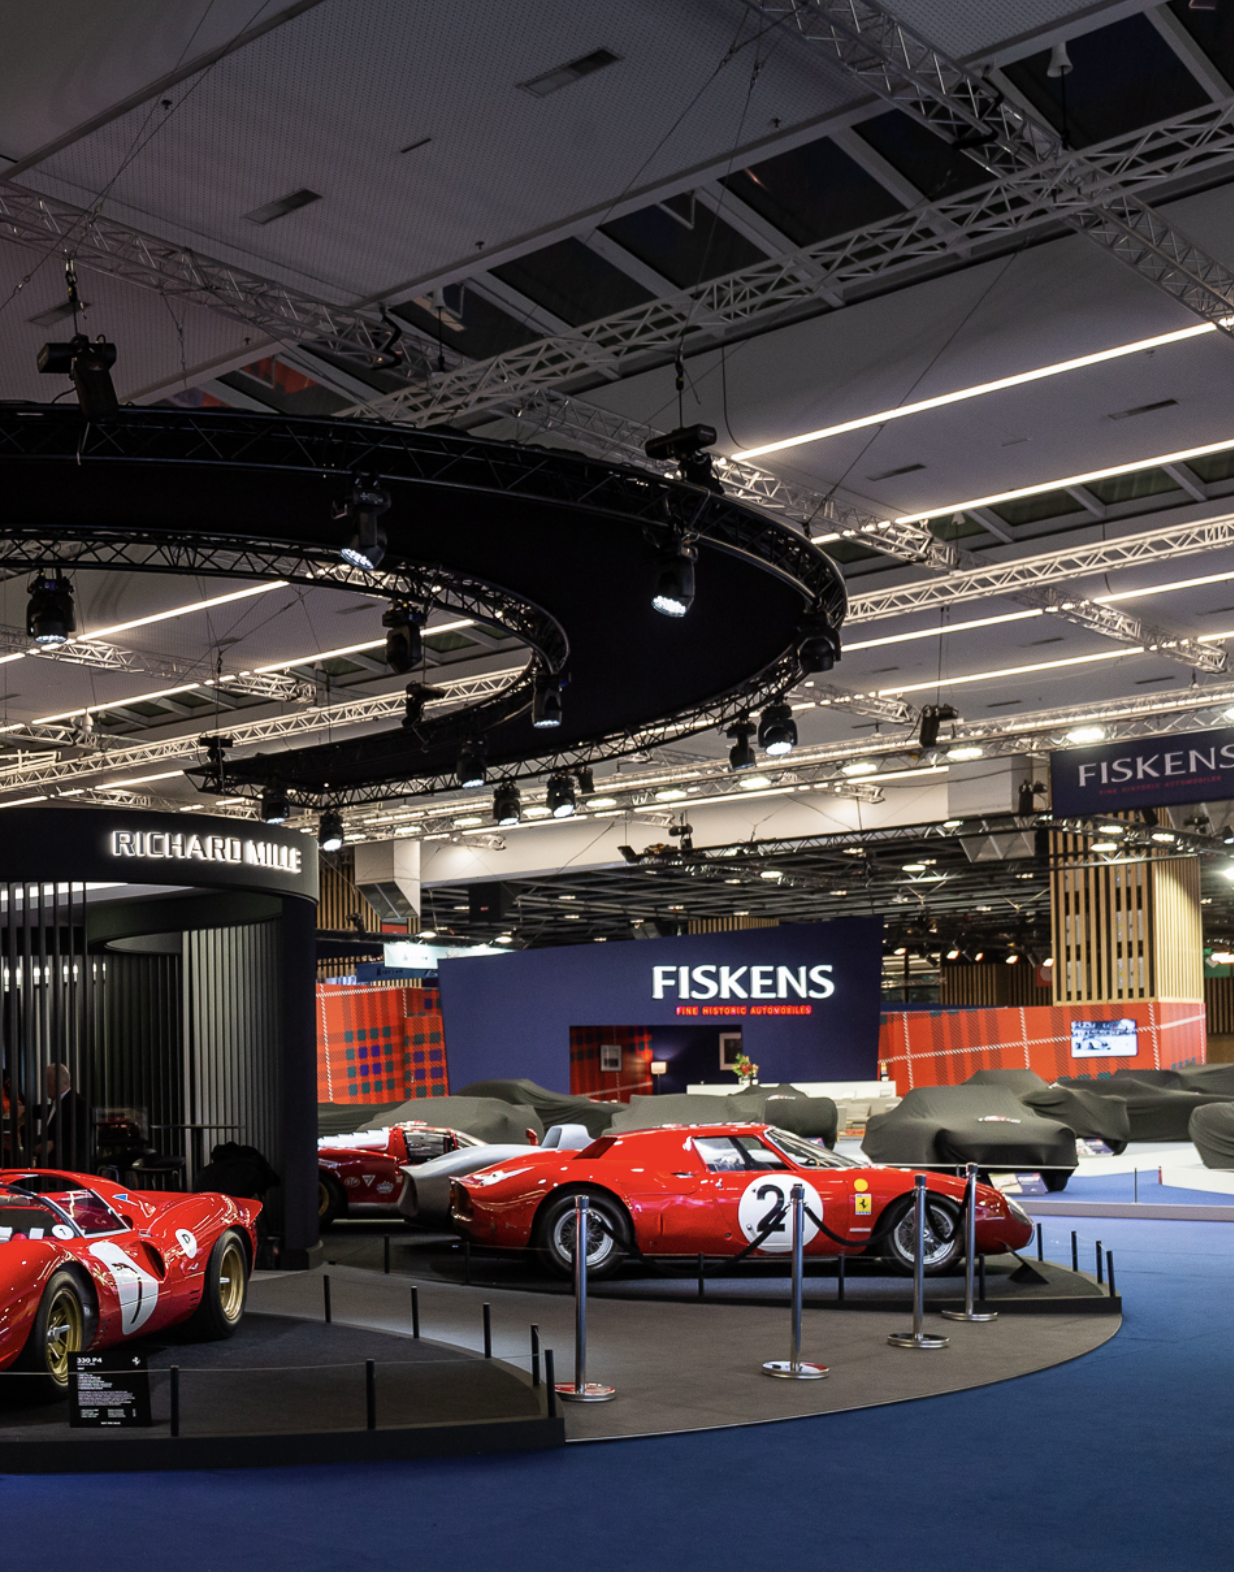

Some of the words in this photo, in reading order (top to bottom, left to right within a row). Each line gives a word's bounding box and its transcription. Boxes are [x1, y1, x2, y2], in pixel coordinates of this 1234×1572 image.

[1078, 744, 1234, 787] FISKENS
[112, 830, 243, 862] RICHARD
[247, 839, 302, 874] MILLE
[652, 965, 835, 1000] FISKENS
[676, 1006, 698, 1016] FINE
[702, 1005, 747, 1016] HISTORIC
[750, 1005, 812, 1015] AUTOMOBILES
[756, 1184, 785, 1232] 2
